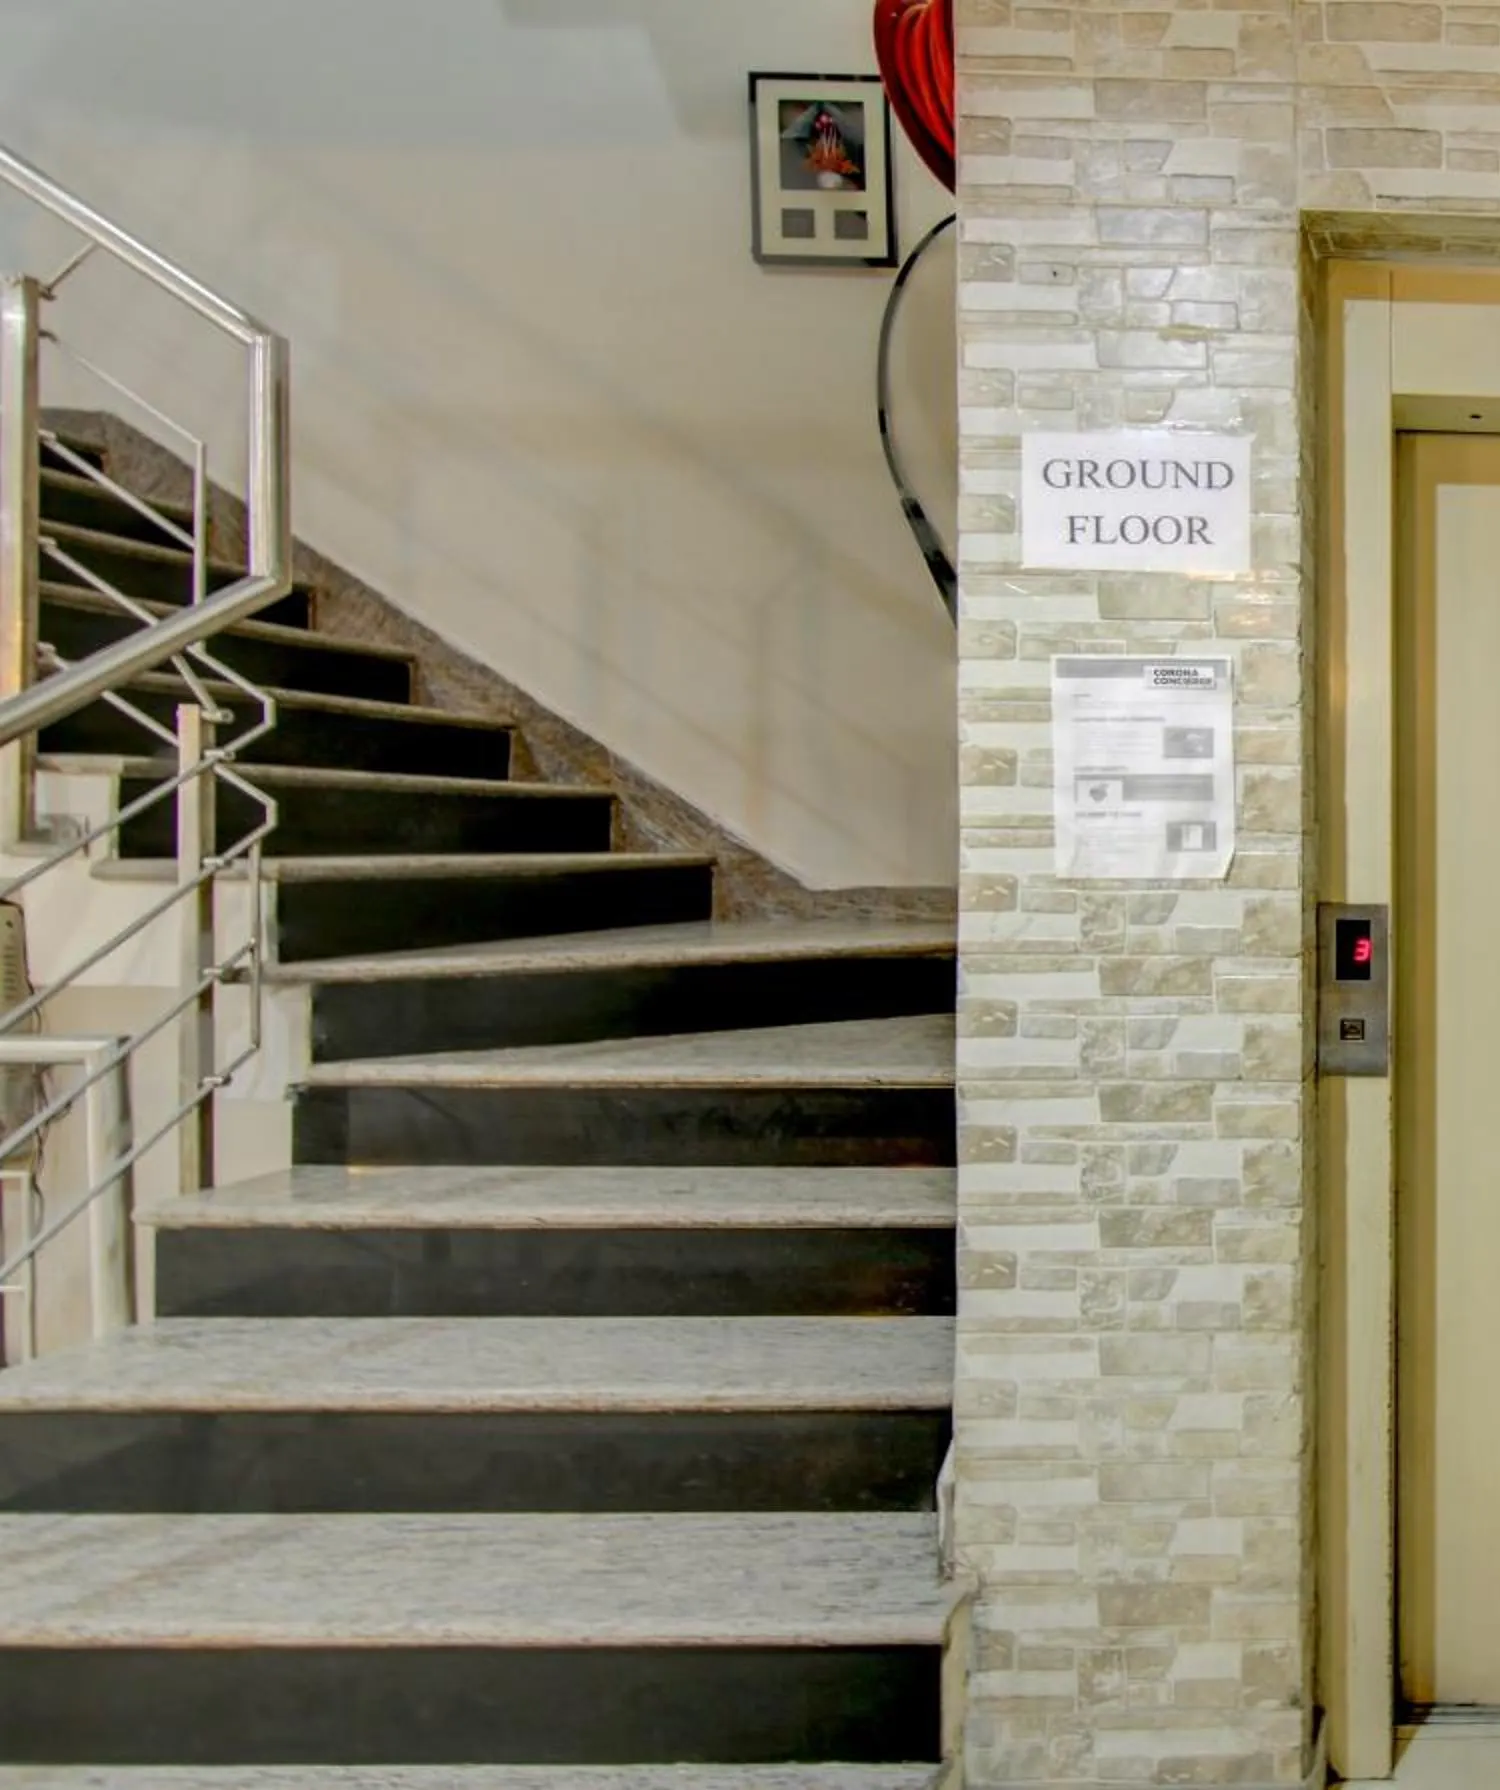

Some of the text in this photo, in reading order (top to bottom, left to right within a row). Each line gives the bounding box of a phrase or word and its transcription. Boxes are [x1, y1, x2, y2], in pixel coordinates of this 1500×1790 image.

[1042, 458, 1234, 490] GROUND
[1065, 514, 1215, 545] FLOOR
[1153, 669, 1199, 677] CORONA
[1353, 938, 1373, 962] 3
